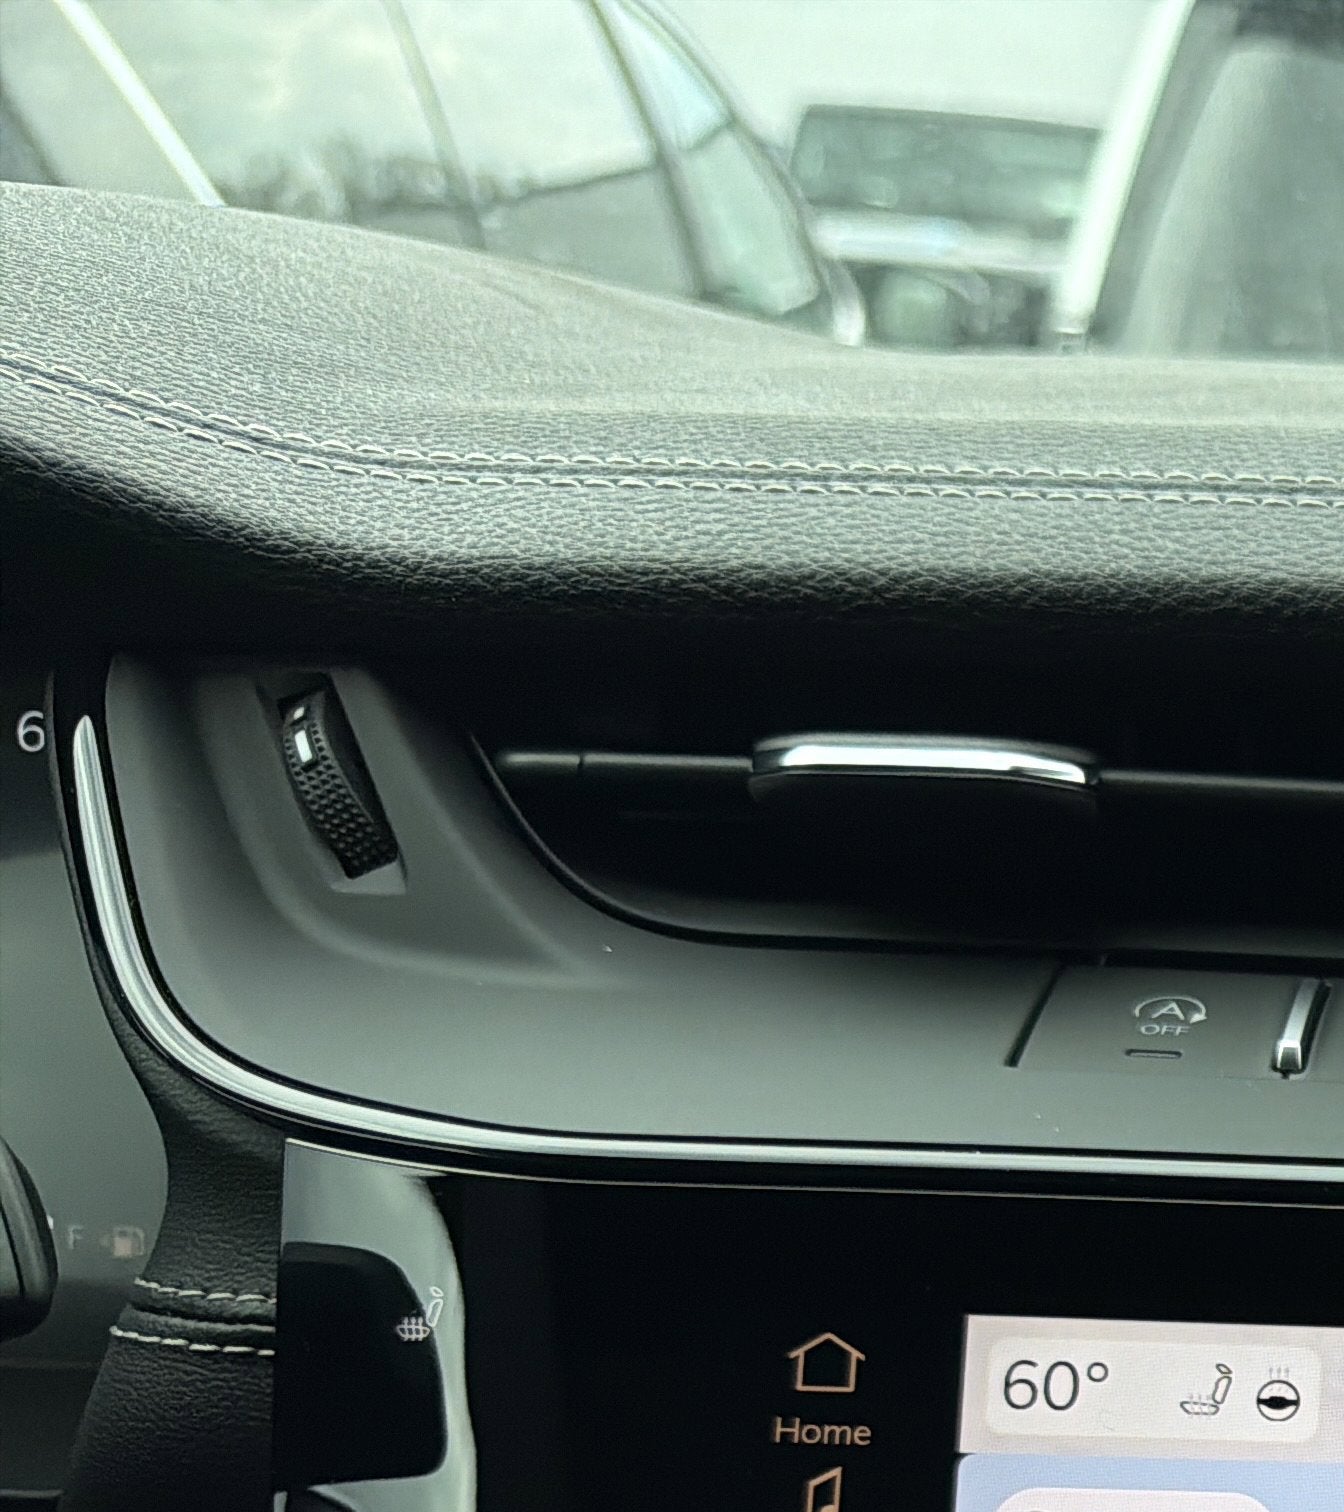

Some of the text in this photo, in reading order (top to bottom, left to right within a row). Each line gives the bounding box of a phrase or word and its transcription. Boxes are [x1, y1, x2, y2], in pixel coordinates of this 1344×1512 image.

[17, 711, 45, 752] 6
[1141, 1025, 1190, 1035] OFF
[773, 1418, 872, 1446] Home
